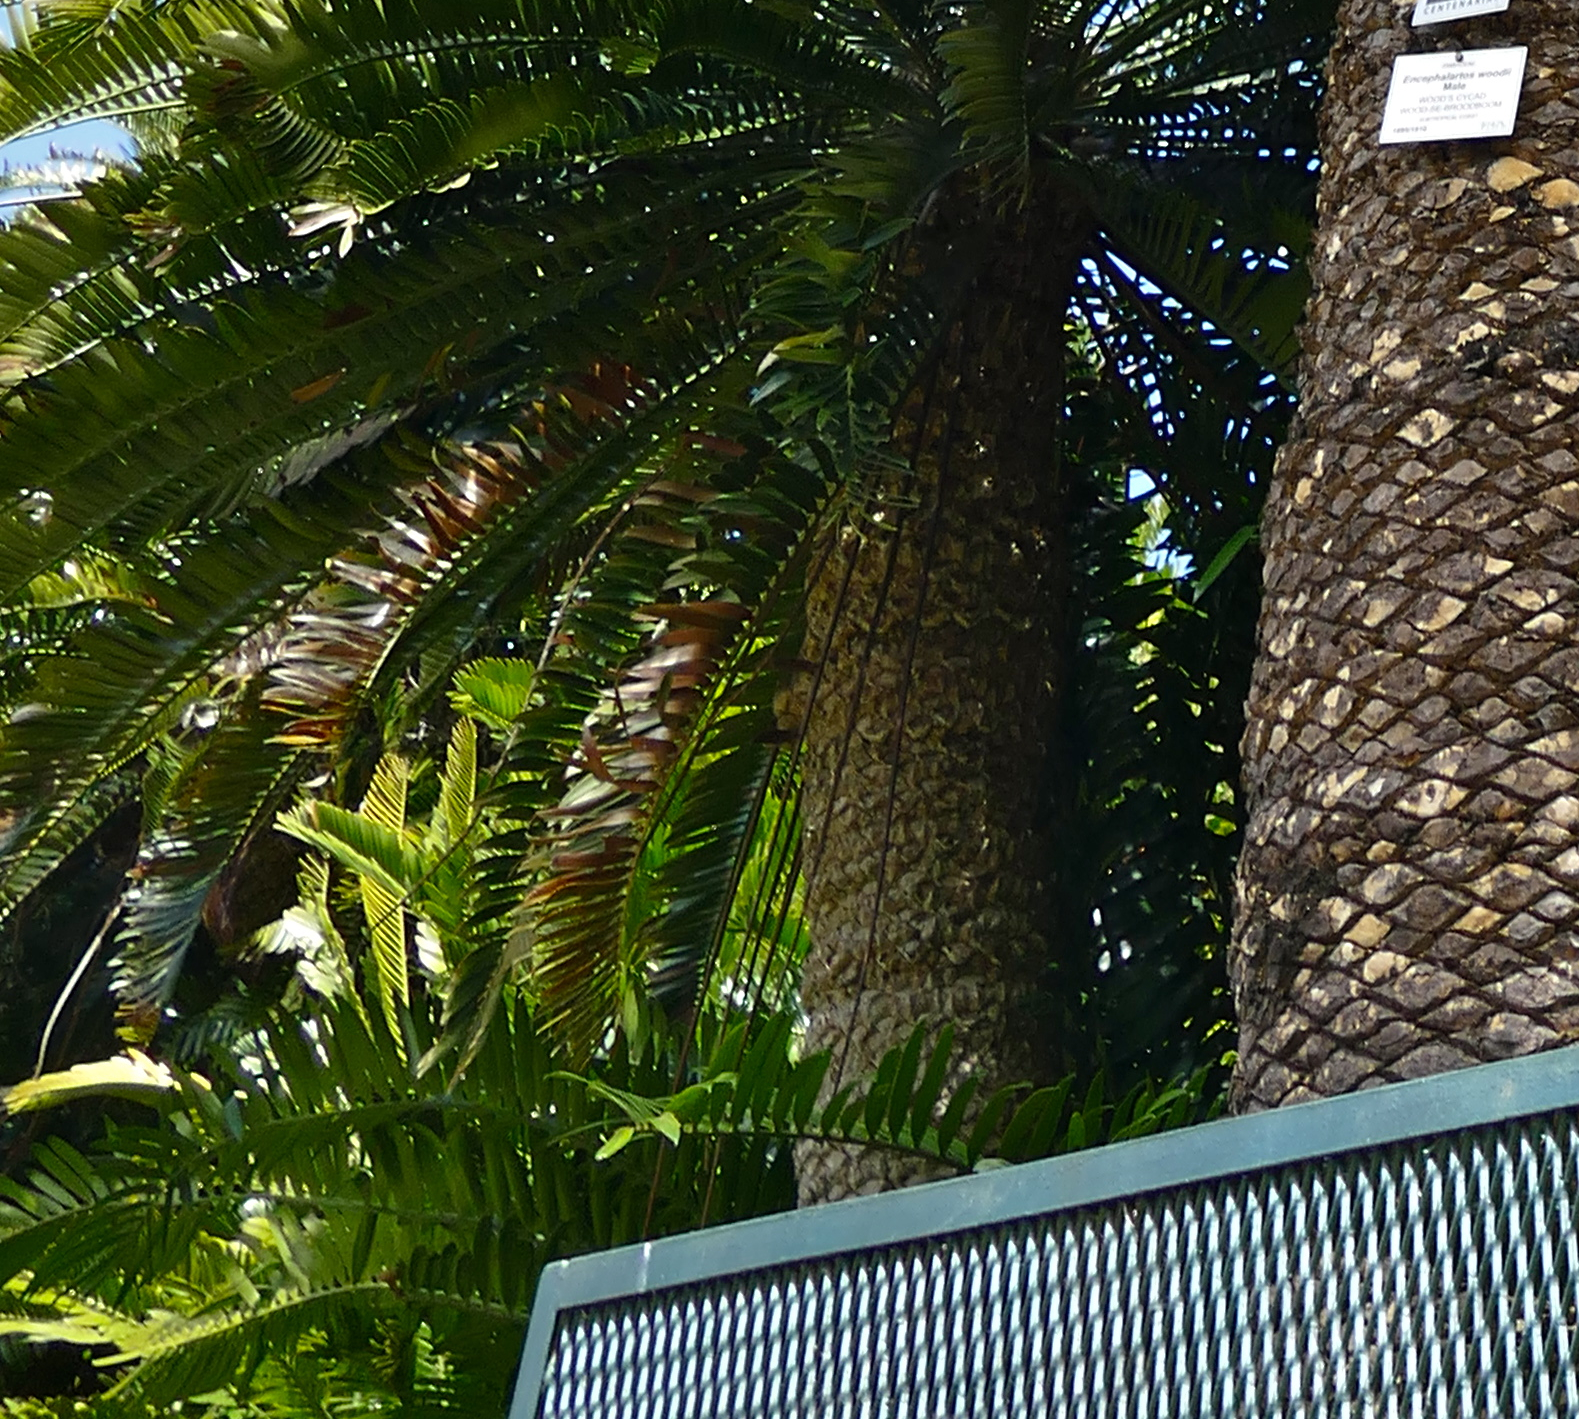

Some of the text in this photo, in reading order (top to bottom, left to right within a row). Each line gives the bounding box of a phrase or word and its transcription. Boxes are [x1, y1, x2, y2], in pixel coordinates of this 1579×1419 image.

[1402, 71, 1474, 84] Encephalartos
[1443, 82, 1466, 91] Male
[1456, 92, 1487, 101] CYCAD
